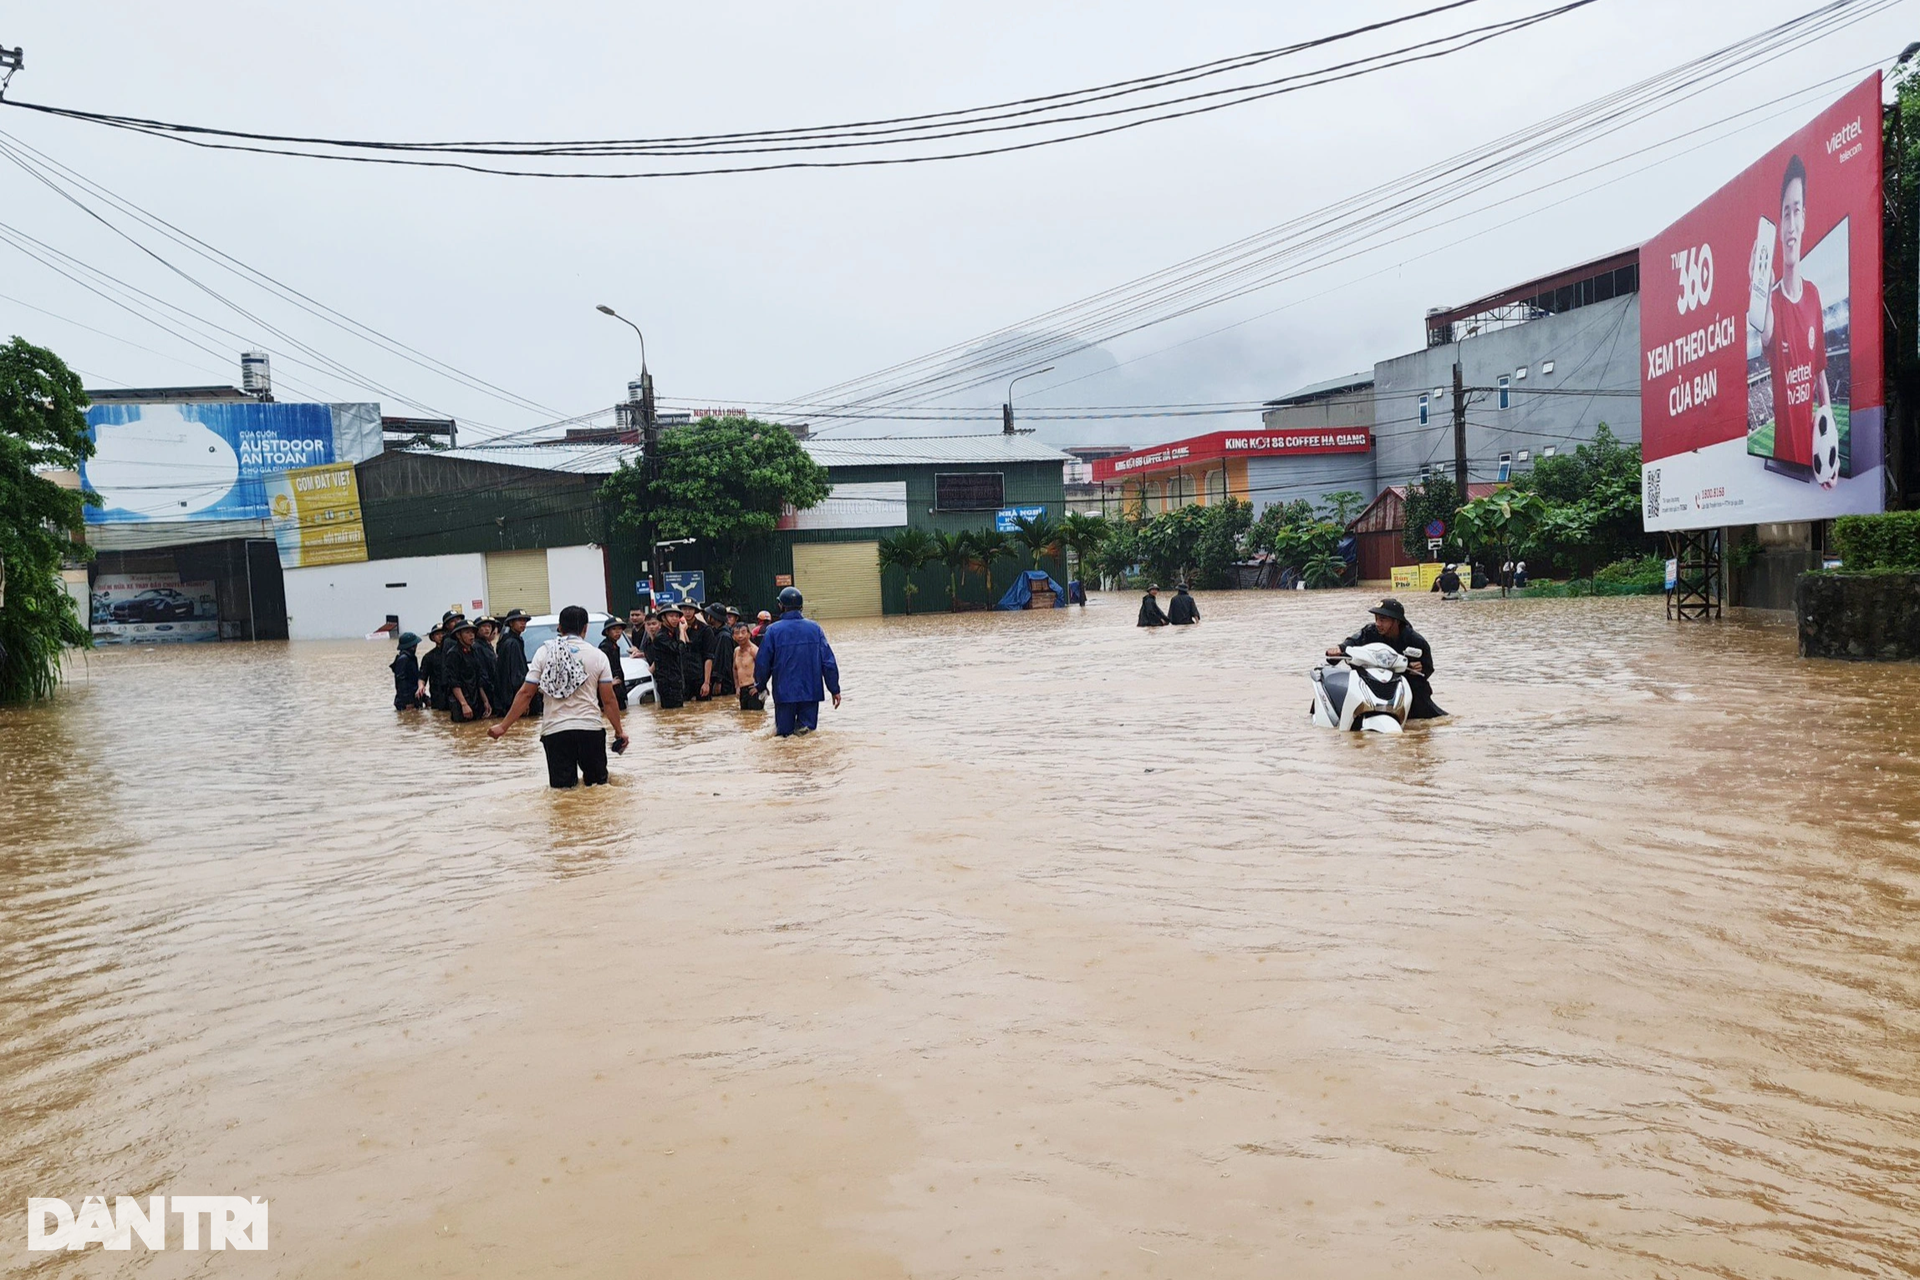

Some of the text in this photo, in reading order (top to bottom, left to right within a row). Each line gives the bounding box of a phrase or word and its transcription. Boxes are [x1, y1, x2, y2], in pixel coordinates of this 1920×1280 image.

[1826, 116, 1862, 154] viettel
[1840, 143, 1862, 163] telecom
[1647, 313, 1735, 381] XEM THEO CÁCH
[1785, 362, 1812, 384] viettel
[1669, 368, 1717, 417] CỦA BẠN
[1787, 383, 1810, 405] tv360
[240, 440, 324, 452] AUSTDOOR
[1225, 438, 1248, 449] KING
[1271, 437, 1284, 448] 88
[1285, 436, 1320, 447] COFFEE
[1321, 434, 1335, 446] HÀ
[1336, 434, 1366, 445] GIANG
[241, 451, 306, 464] AN TOÀN
